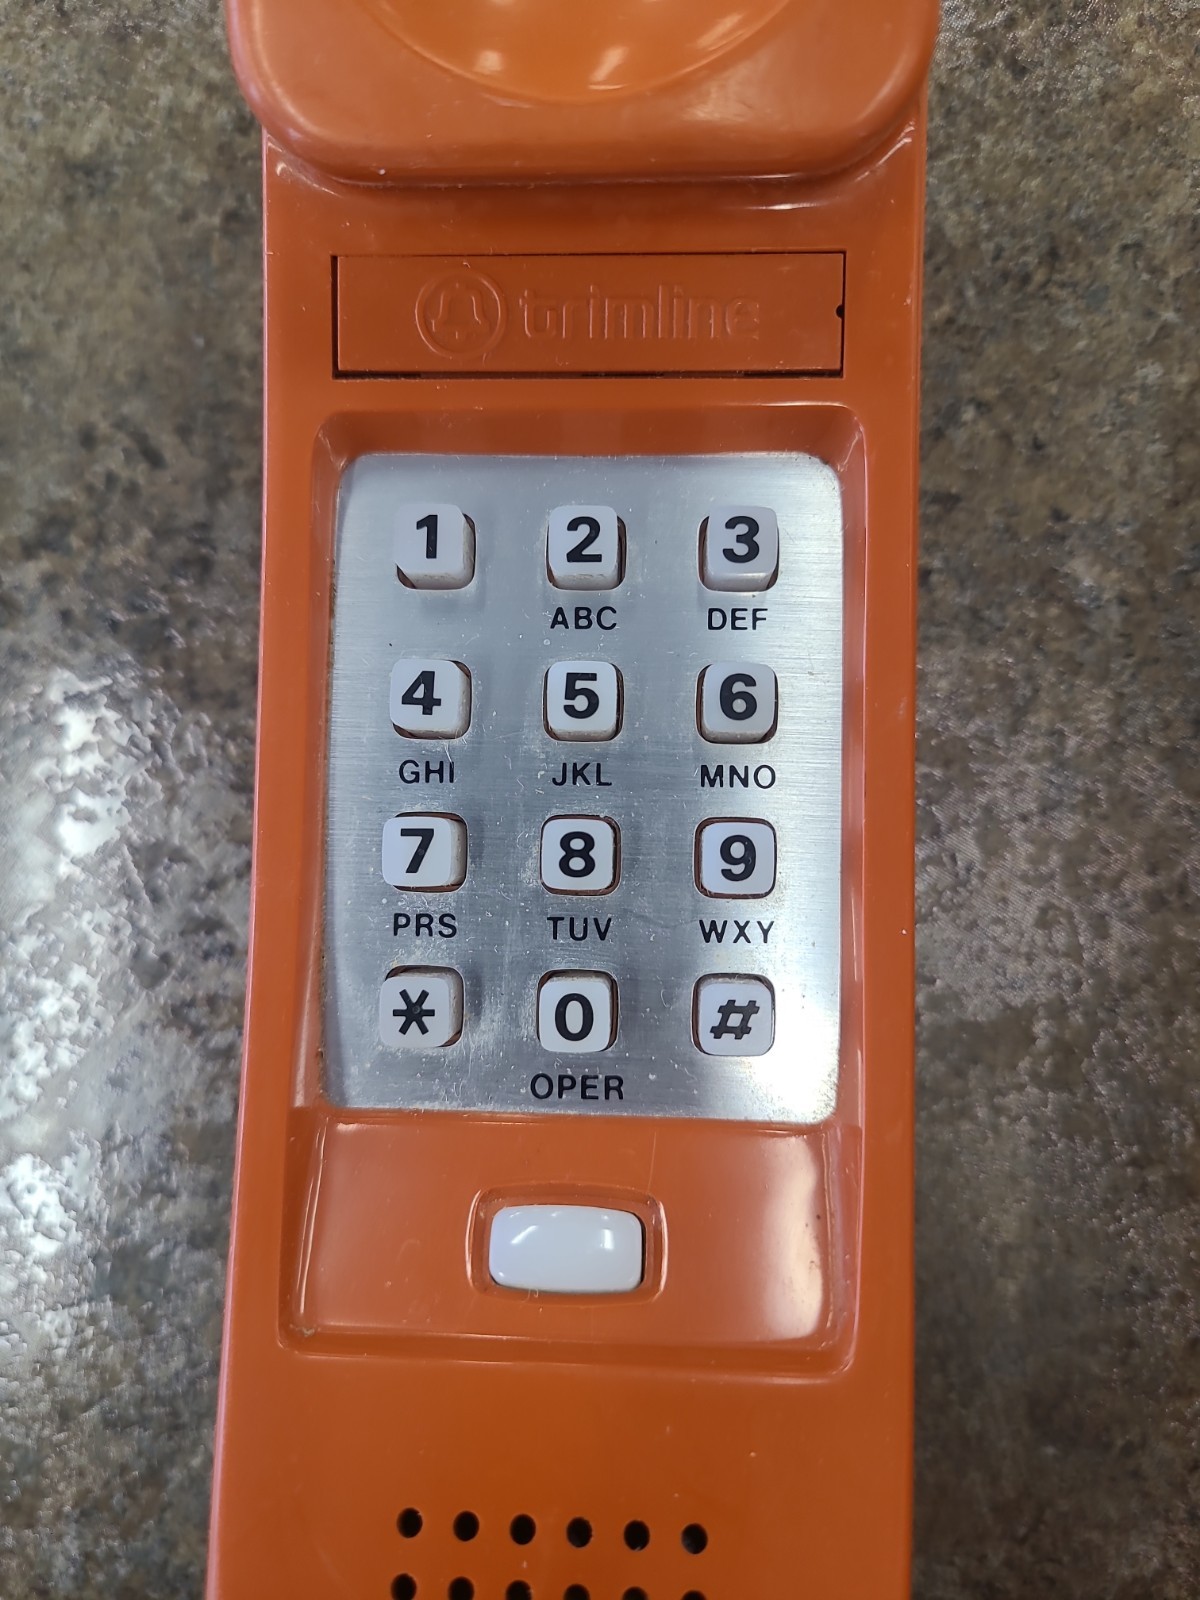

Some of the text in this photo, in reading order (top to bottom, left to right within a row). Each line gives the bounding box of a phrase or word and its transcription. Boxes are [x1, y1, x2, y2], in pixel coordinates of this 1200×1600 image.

[519, 284, 761, 340] trimline
[416, 514, 438, 559] 1
[566, 516, 603, 563] 2
[722, 515, 760, 564] 3
[550, 605, 617, 631] ABC
[707, 607, 768, 631] DEF
[401, 670, 442, 716] 4
[563, 672, 600, 720] 5
[719, 673, 758, 721] 6
[398, 759, 455, 784] GHI
[552, 762, 613, 787] JKL
[700, 764, 776, 789] MNO
[400, 828, 435, 874] 7
[558, 831, 596, 878] 8
[719, 834, 757, 882] 9
[393, 912, 457, 939] PRS
[546, 916, 612, 942] TUV
[698, 919, 774, 944] WXY
[530, 1073, 624, 1100] OPER
